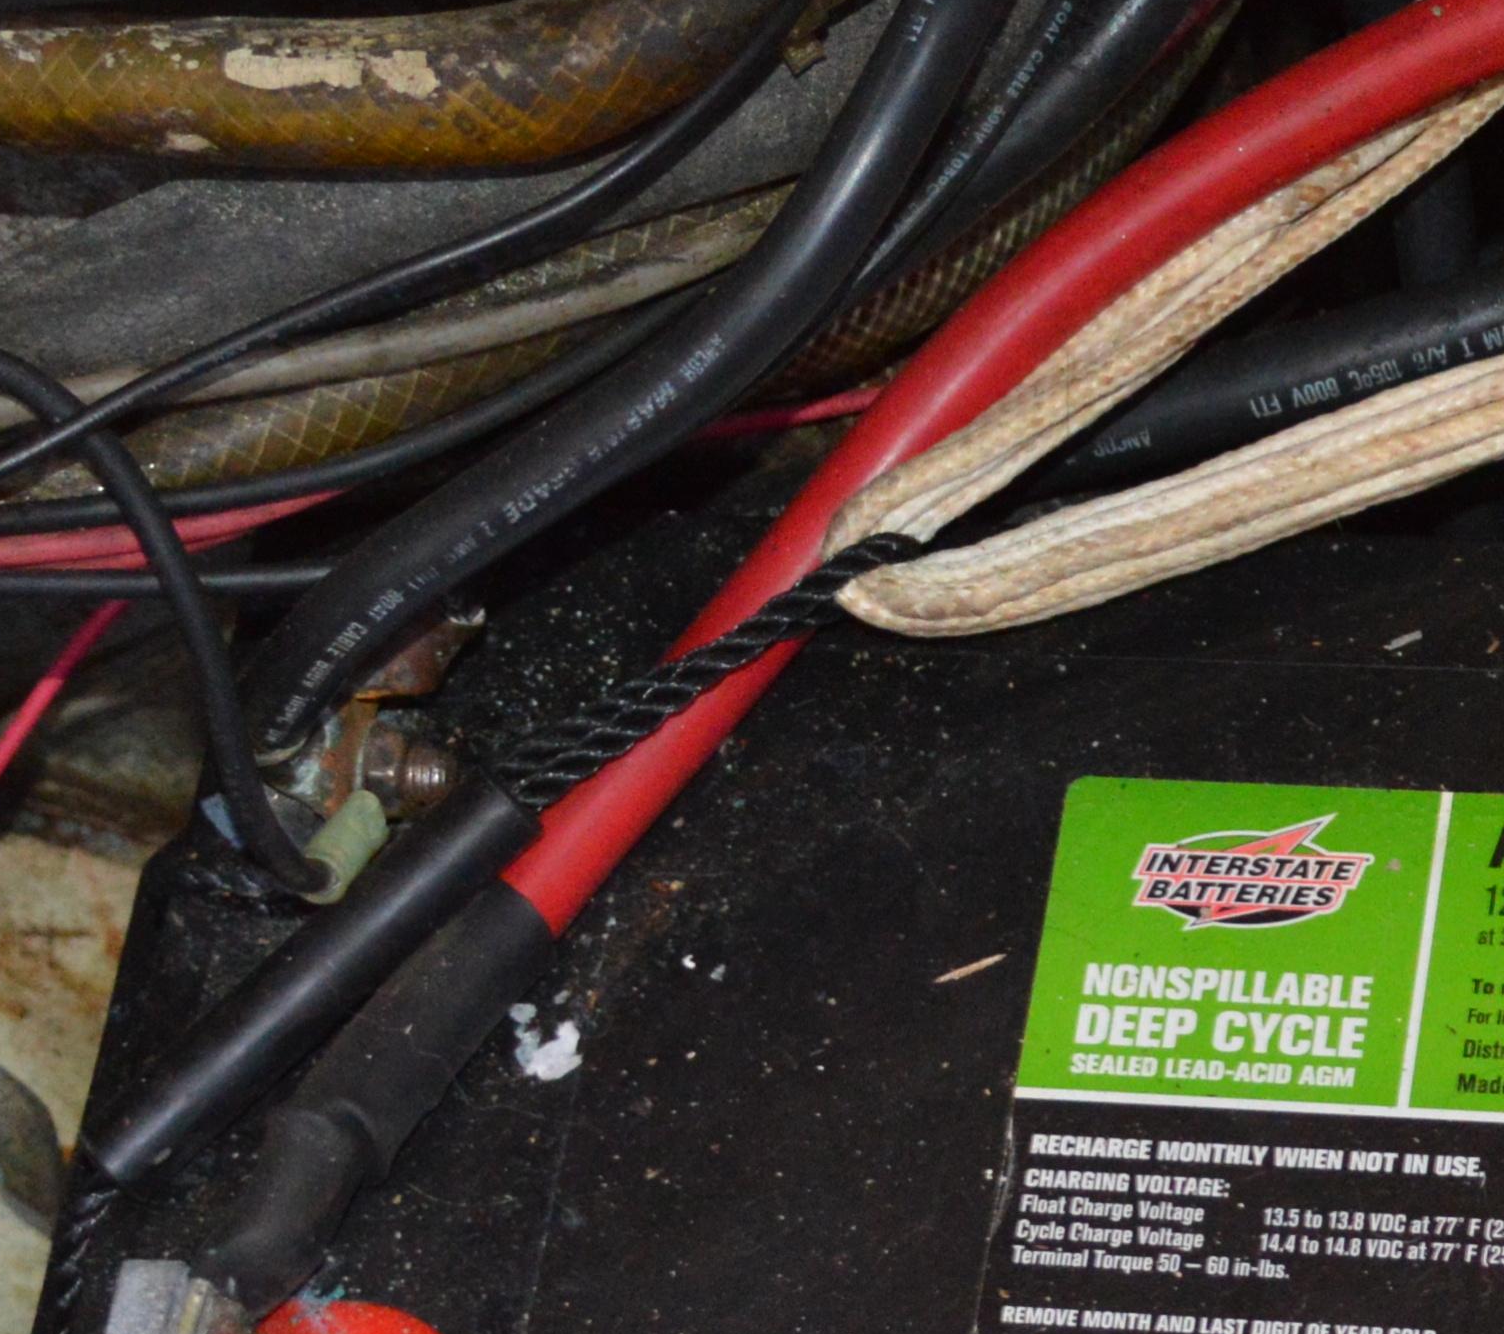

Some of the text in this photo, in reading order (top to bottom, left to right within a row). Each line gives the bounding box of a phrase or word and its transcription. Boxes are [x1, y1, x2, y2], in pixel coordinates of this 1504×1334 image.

[1145, 852, 1354, 880] INTERSTATE
[1146, 881, 1334, 906] BATTERIES
[1082, 962, 1373, 1009] NONSPILLABLE
[1471, 978, 1494, 994] To
[1467, 1007, 1491, 1024] For
[1073, 1003, 1368, 1058] DEEP CYCLE
[1070, 1052, 1355, 1086] SEALED LEAD-ACID AGM
[1029, 1133, 1152, 1159] RECHARGE
[1156, 1140, 1268, 1165] MONTHLY
[1274, 1146, 1343, 1169] WHEN
[1348, 1150, 1398, 1172] NOT
[1402, 1153, 1428, 1174] IN
[1024, 1167, 1230, 1197] CHARGING VOLTAGE:
[1019, 1193, 1204, 1225] Float Charge Voltage
[1264, 1207, 1299, 1227] 13.5
[1303, 1209, 1322, 1228] to
[1329, 1210, 1364, 1231] 13.8
[1369, 1212, 1406, 1233] VDC
[1409, 1216, 1430, 1234] at
[1467, 1217, 1481, 1236] F
[1001, 1305, 1078, 1326] REMOVE
[1081, 1310, 1151, 1330] MONTH
[1154, 1314, 1195, 1333] AND
